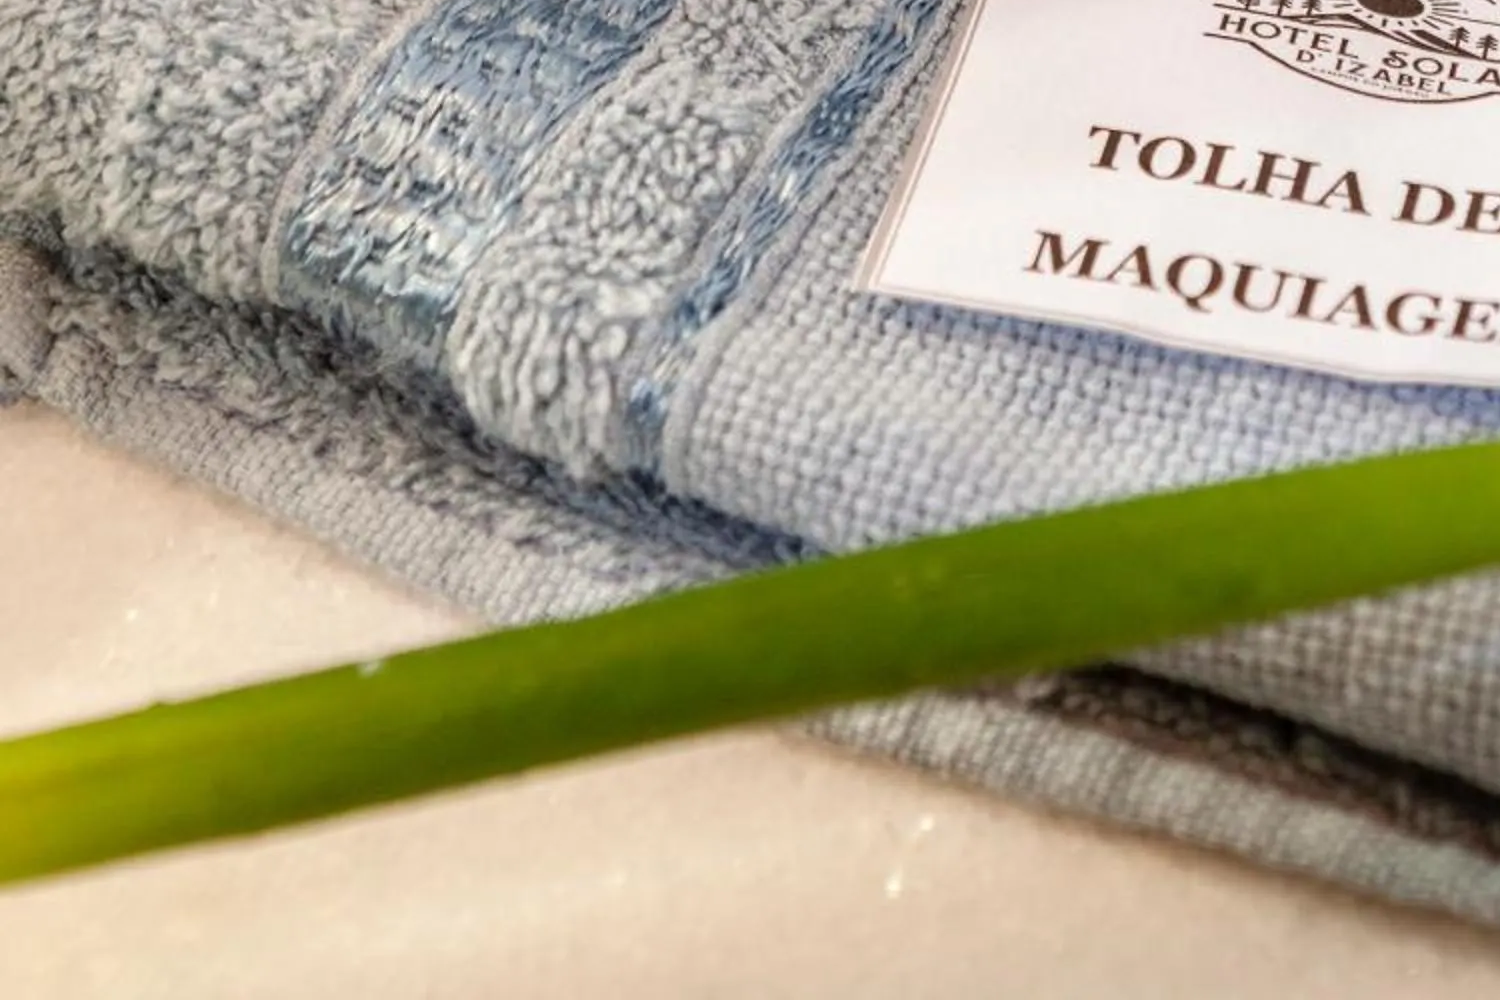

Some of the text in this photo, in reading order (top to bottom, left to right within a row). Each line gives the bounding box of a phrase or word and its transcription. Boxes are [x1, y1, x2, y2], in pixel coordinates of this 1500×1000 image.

[1219, 13, 1359, 60] HOTEL
[1335, 50, 1453, 95] IZABEL
[1088, 124, 1370, 216] TOLHA
